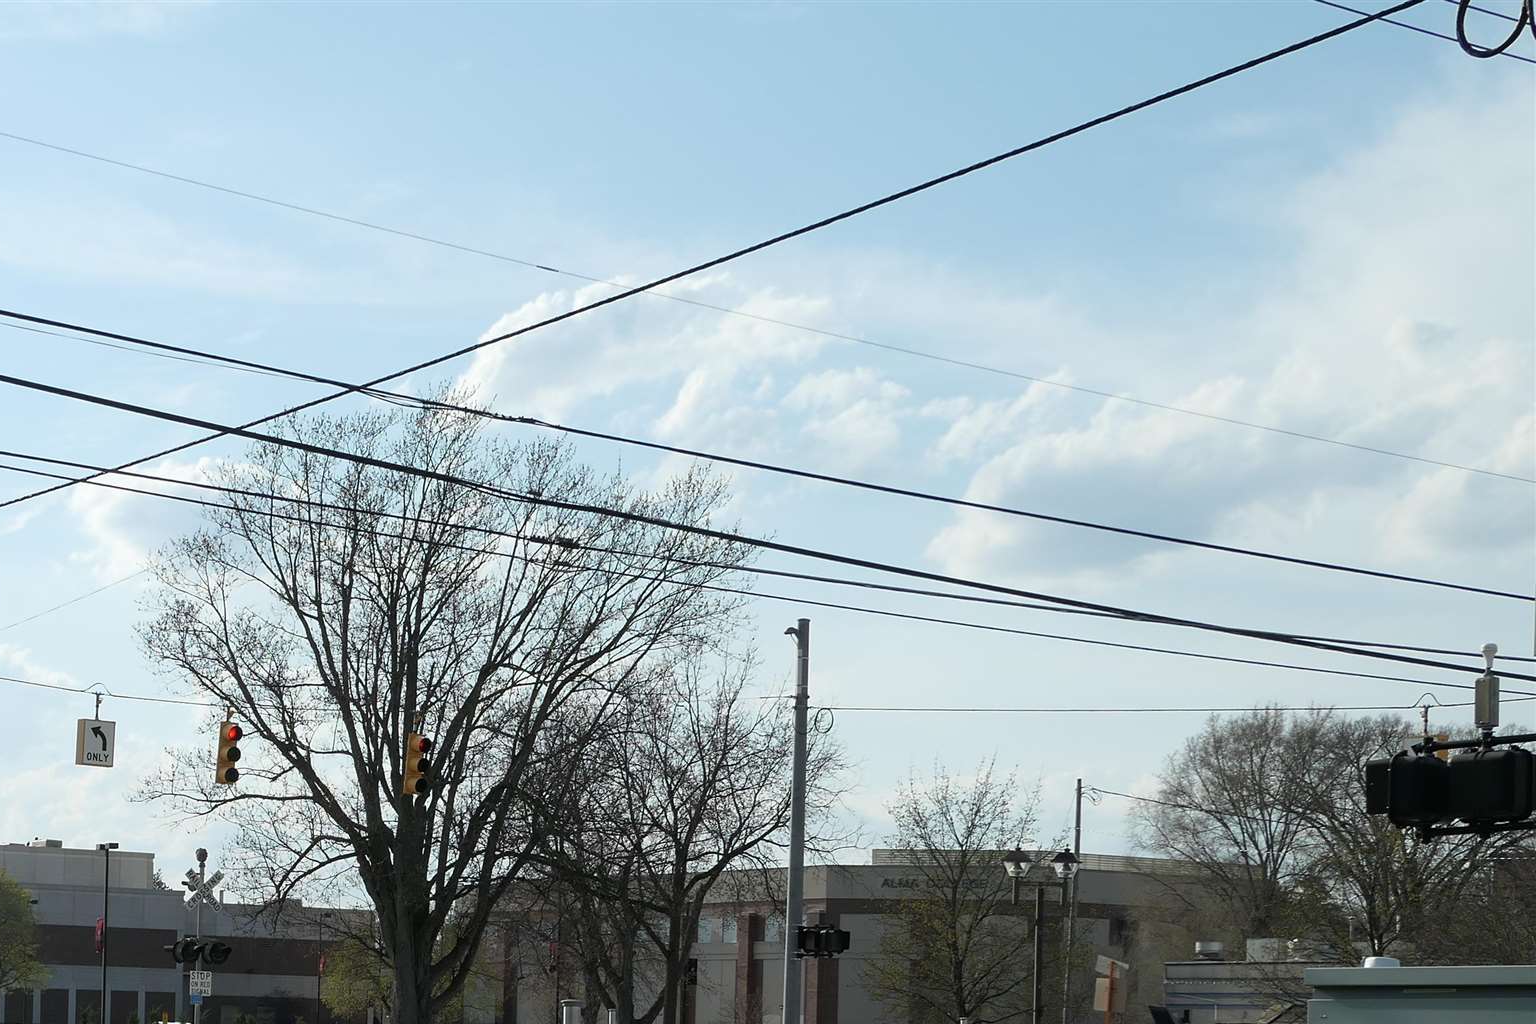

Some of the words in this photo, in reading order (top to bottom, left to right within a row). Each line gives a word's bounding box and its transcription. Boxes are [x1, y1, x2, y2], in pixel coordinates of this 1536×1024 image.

[86, 752, 110, 762] ONLY
[927, 878, 988, 889] COLEGE
[192, 971, 210, 980] STOP
